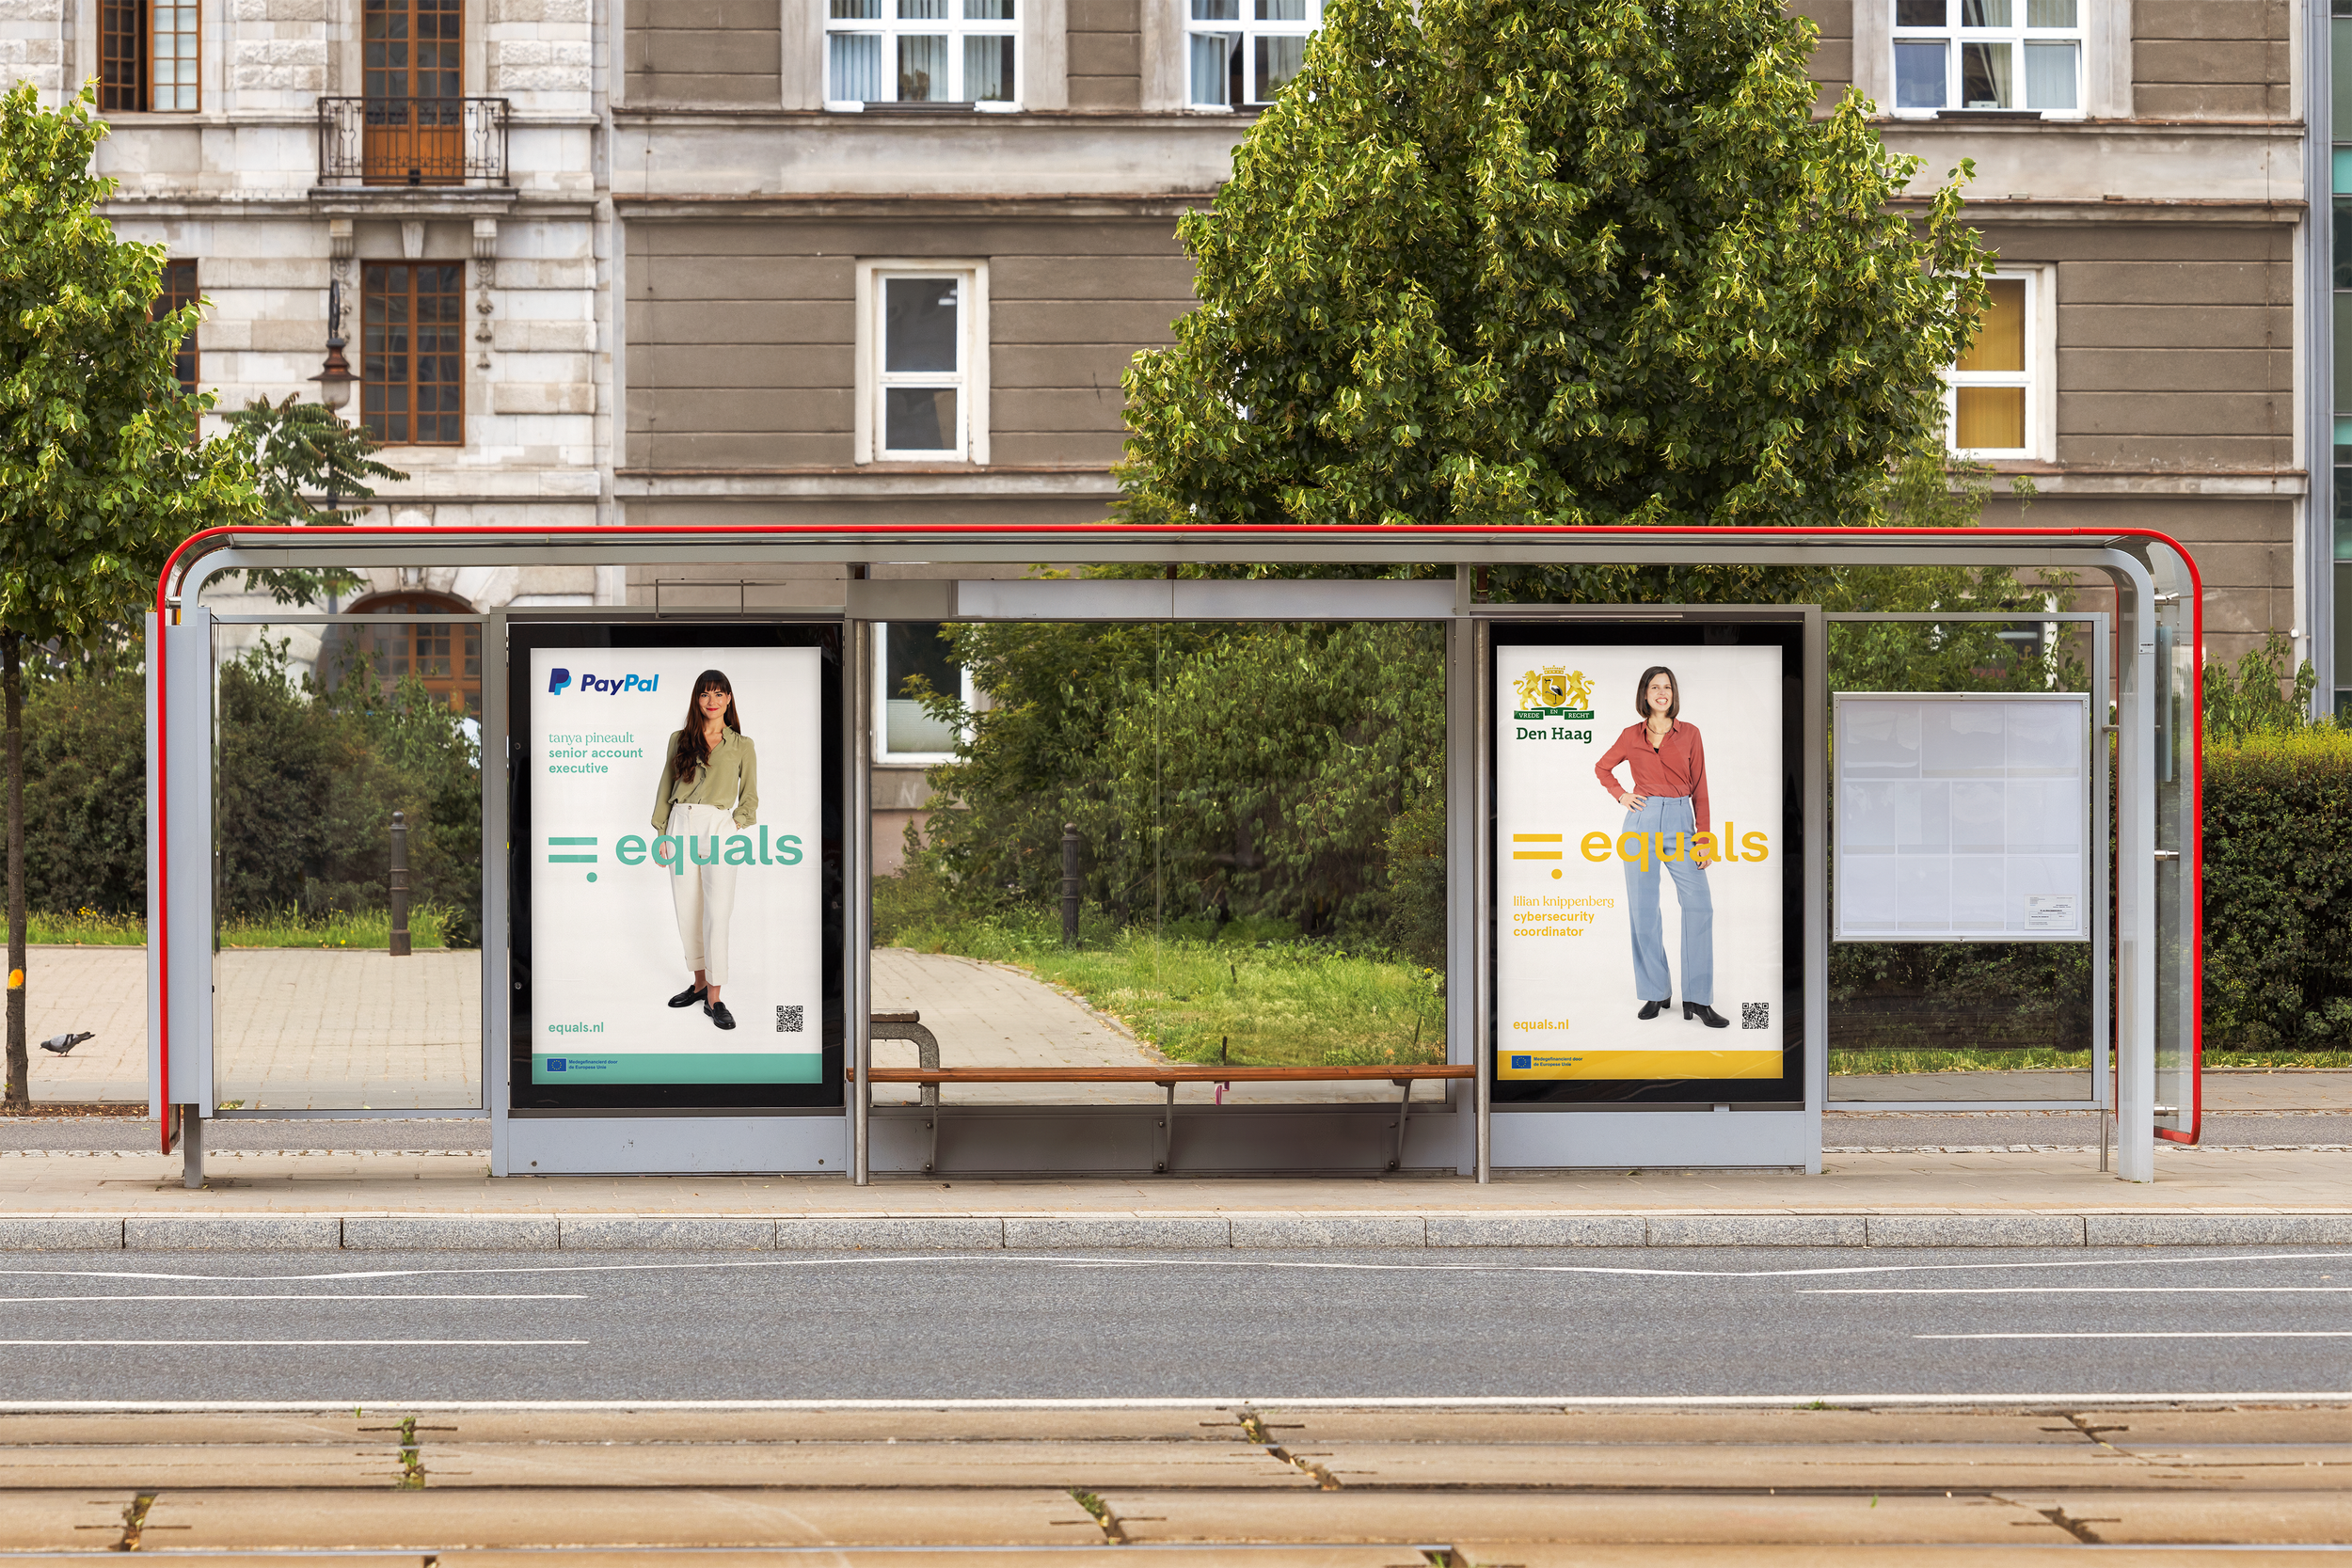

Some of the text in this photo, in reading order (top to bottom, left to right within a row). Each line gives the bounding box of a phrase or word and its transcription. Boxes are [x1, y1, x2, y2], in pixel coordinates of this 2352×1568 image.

[580, 673, 660, 696] PayPal
[548, 732, 634, 746] tanya pineault
[1516, 727, 1593, 744] Den Haag
[548, 747, 644, 758] senior account
[548, 762, 609, 773] executive
[615, 825, 803, 875] equals
[1581, 821, 1769, 872] equals
[1513, 895, 1614, 910] lilian knippenberg
[1513, 911, 1595, 923] cybersecurity
[1513, 927, 1584, 937] coordinator
[548, 1022, 604, 1035] equals.nl
[1513, 1019, 1569, 1032] equals.nl
